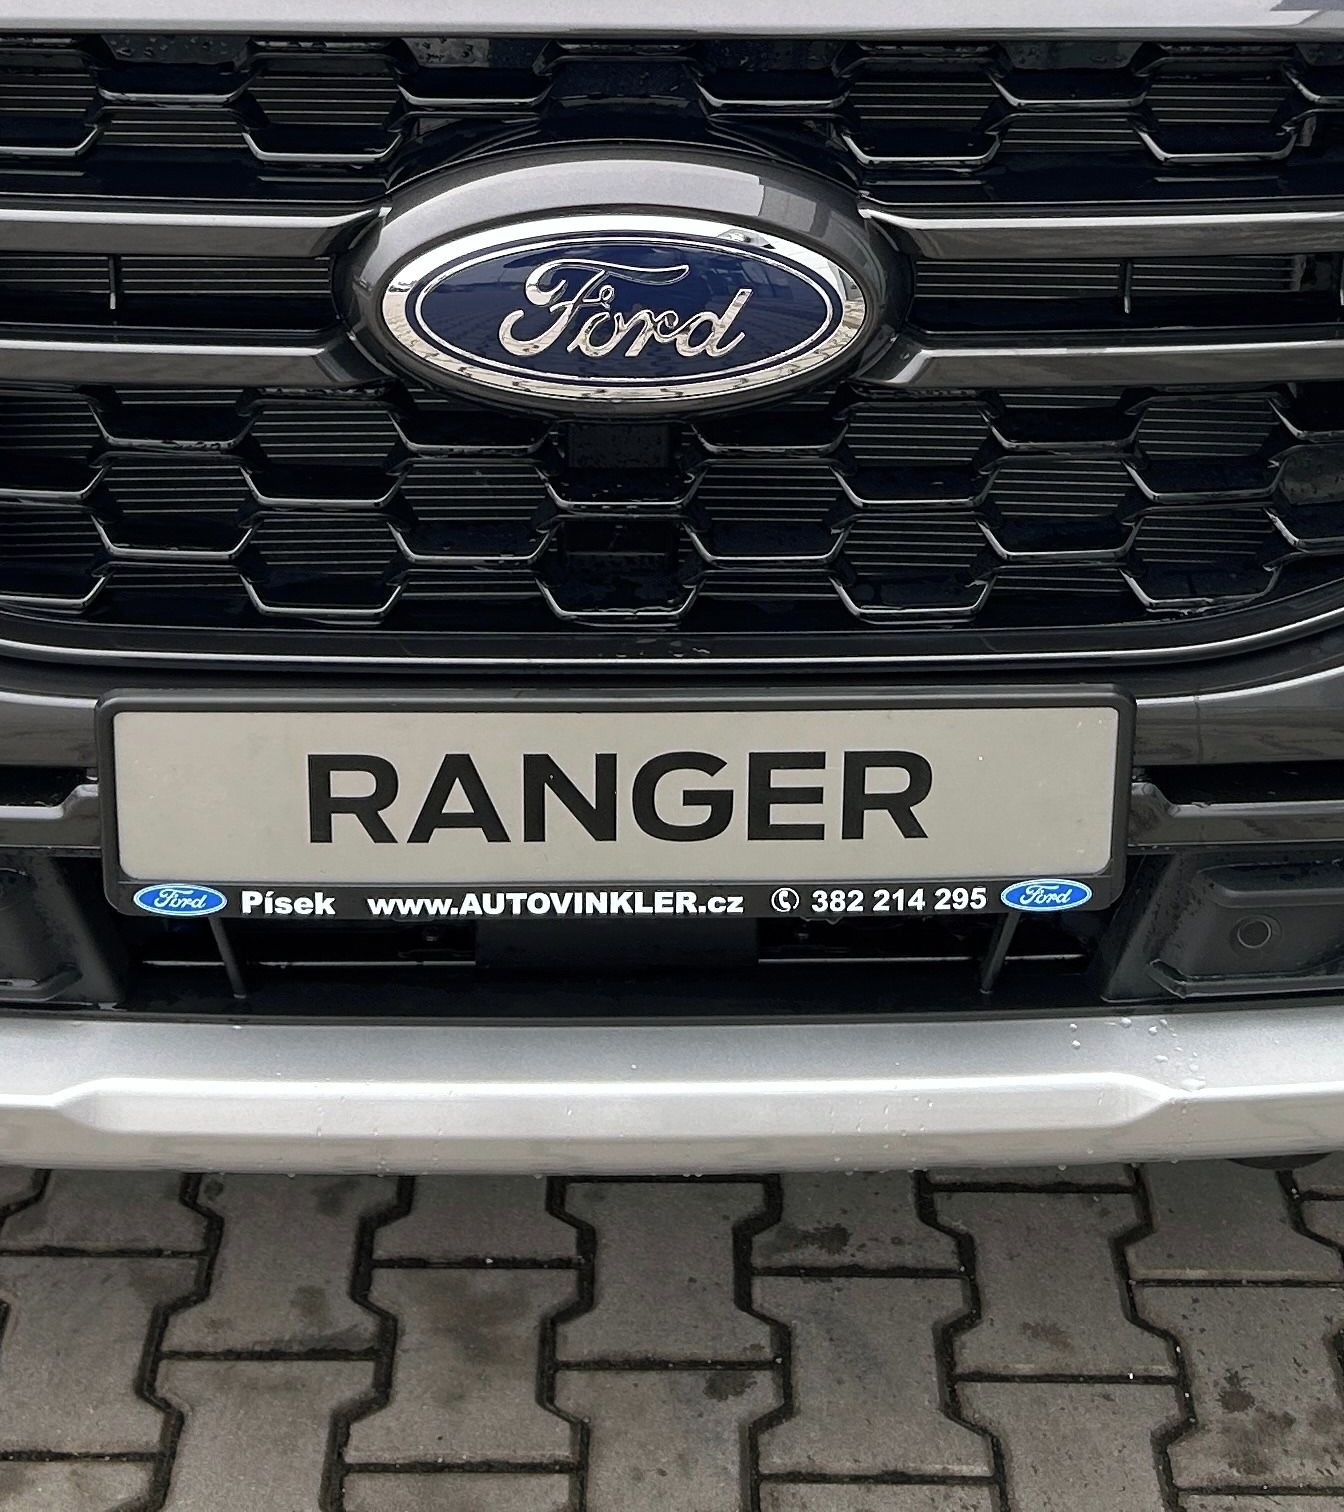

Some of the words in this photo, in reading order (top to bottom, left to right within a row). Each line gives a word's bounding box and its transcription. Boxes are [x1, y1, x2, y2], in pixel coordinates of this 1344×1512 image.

[498, 258, 754, 359] Ford
[307, 749, 933, 843] RANGER
[154, 888, 208, 909] Ford
[240, 890, 336, 915] Písek
[367, 891, 744, 915] www.AUTOVINKLER.cz
[811, 889, 864, 912] 382
[872, 888, 926, 911] 214
[934, 886, 987, 910] 295
[1019, 885, 1071, 905] Ford
